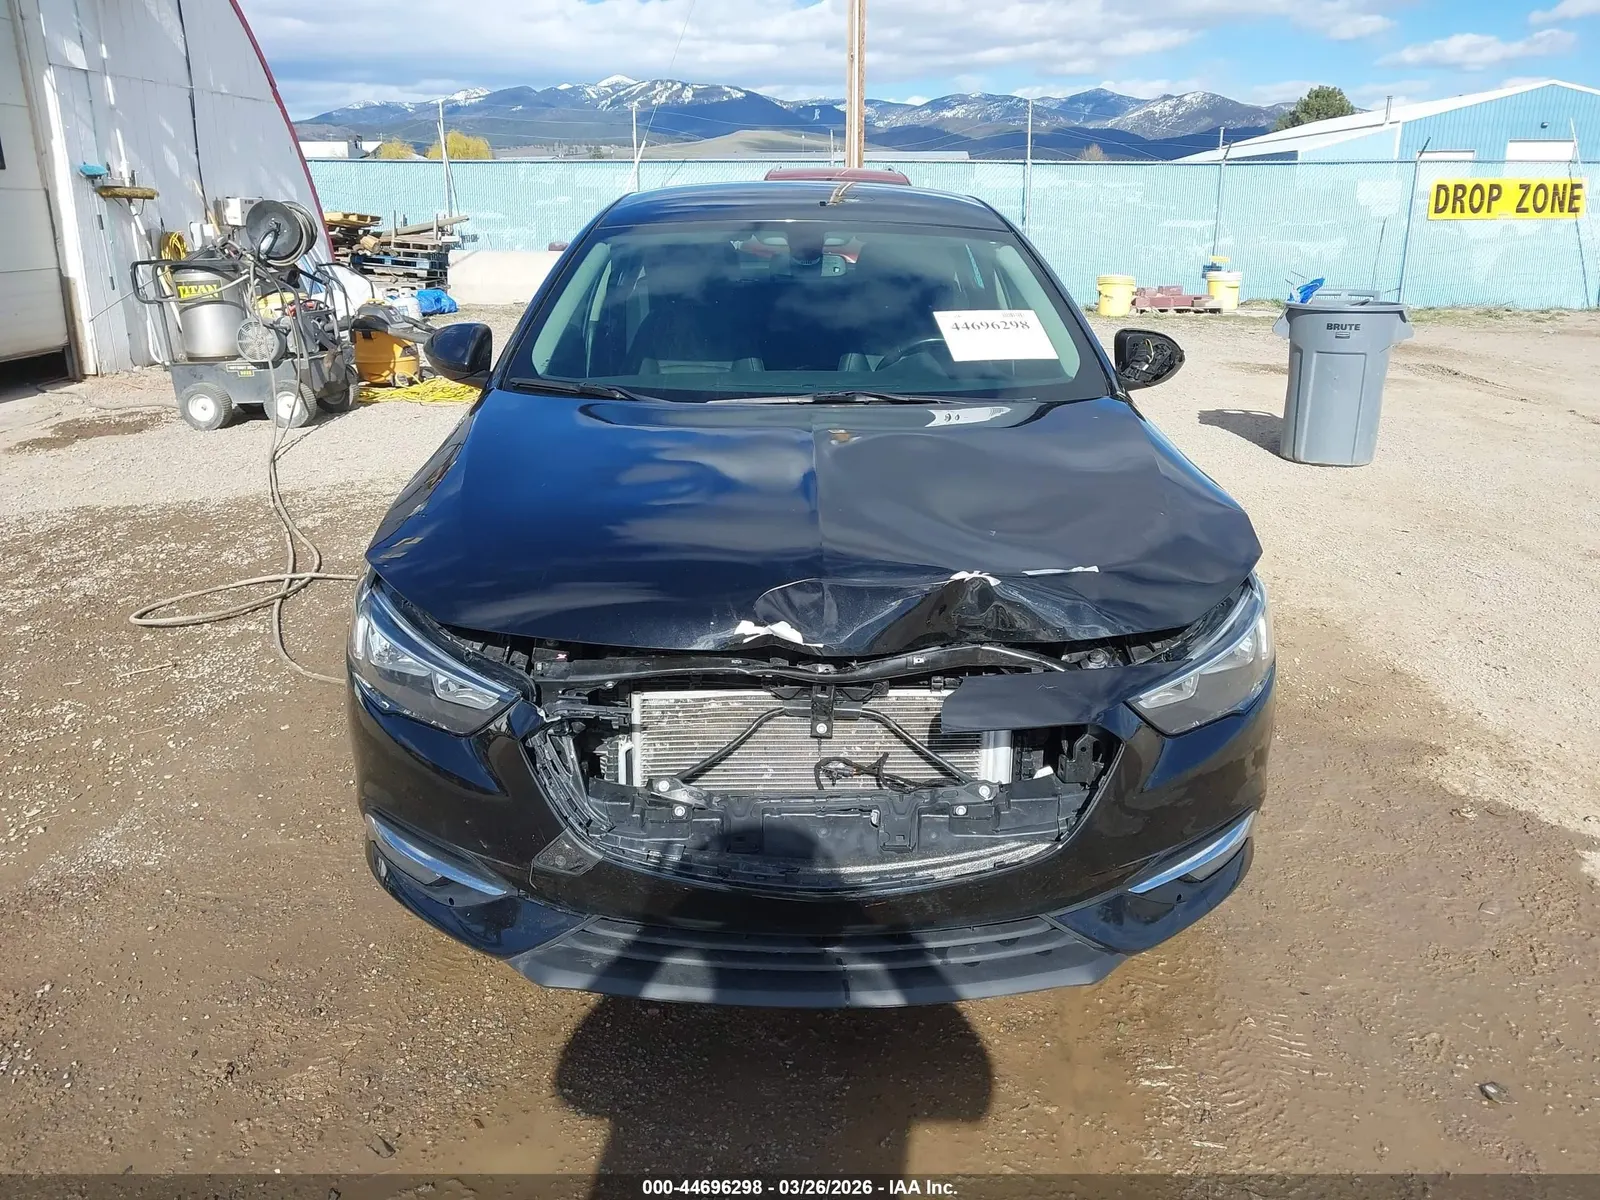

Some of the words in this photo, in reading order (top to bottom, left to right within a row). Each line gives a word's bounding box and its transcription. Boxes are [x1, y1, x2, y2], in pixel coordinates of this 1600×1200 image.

[1433, 183, 1503, 214] DROP
[1515, 183, 1584, 214] ZONE
[177, 284, 219, 299] TITAN
[951, 320, 1031, 331] 44696298
[1326, 322, 1362, 331] BRUTE
